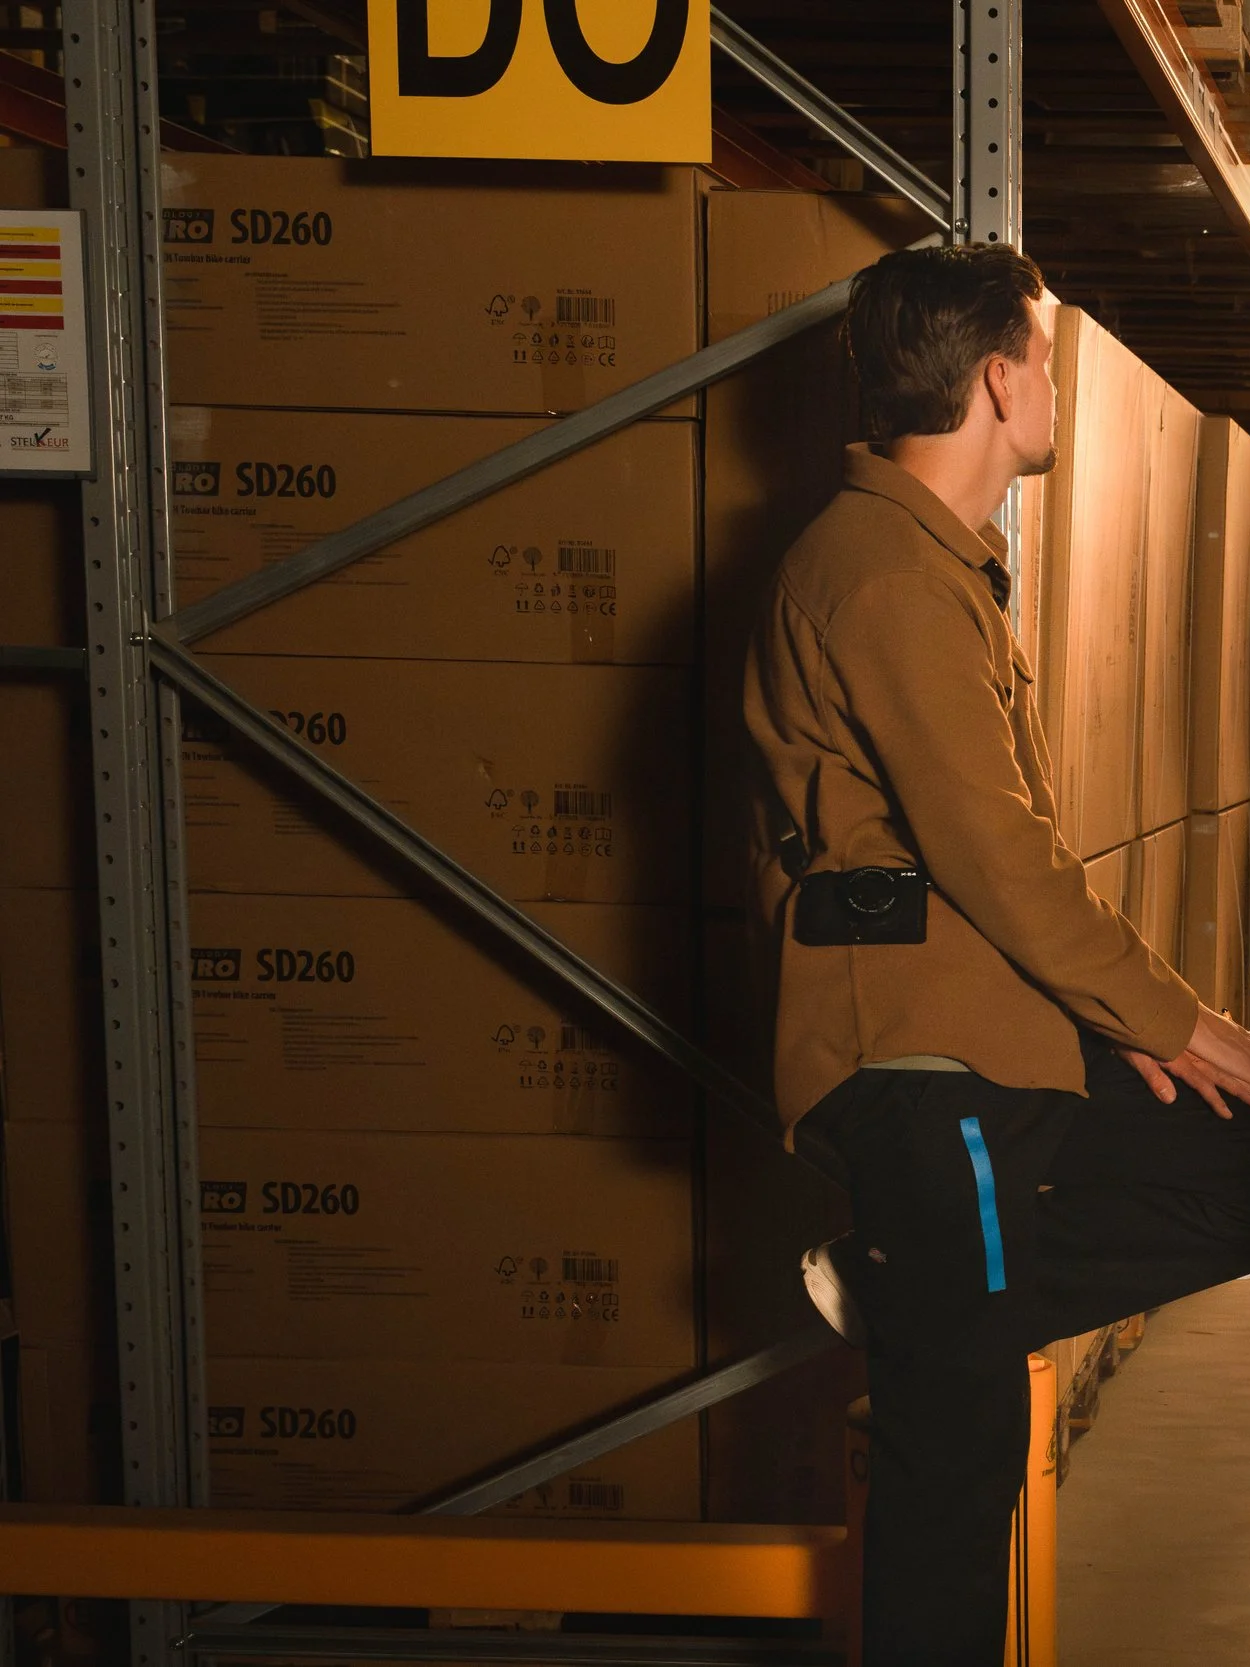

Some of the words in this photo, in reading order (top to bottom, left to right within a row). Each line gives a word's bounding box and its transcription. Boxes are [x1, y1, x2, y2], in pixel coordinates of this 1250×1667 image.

[231, 208, 333, 246] SD260
[236, 462, 337, 498] SD260
[268, 710, 346, 746] 260
[257, 948, 355, 983] SD260
[262, 1181, 360, 1215] SD260
[259, 1407, 356, 1440] SD260
